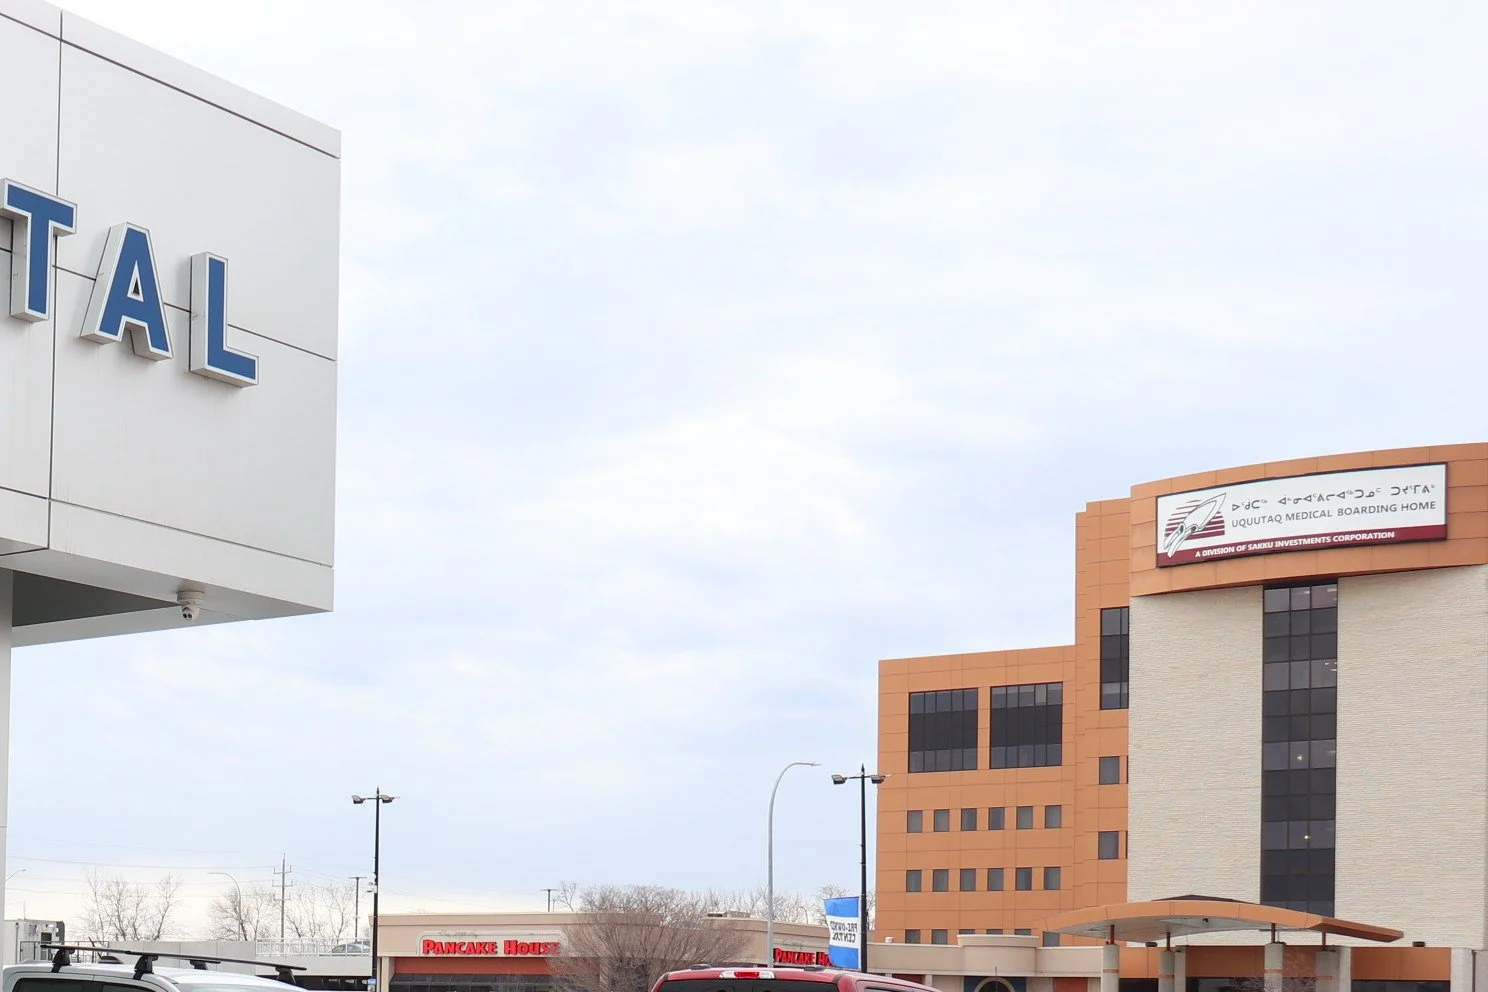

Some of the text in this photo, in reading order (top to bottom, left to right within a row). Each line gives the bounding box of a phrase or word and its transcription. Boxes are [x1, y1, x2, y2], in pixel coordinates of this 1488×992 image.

[1231, 501, 1436, 528] UQUUTAQ MEDICAL BOARDING HOME
[1202, 546, 1235, 556] DIVISION
[1236, 544, 1247, 552] OF
[1247, 541, 1274, 551] SAKKU
[1275, 536, 1331, 548] INVESTMENTS
[1332, 531, 1395, 543] CORPORATION
[422, 939, 560, 956] PANCAKE HOUSE
[773, 947, 816, 966] PANCAKE
